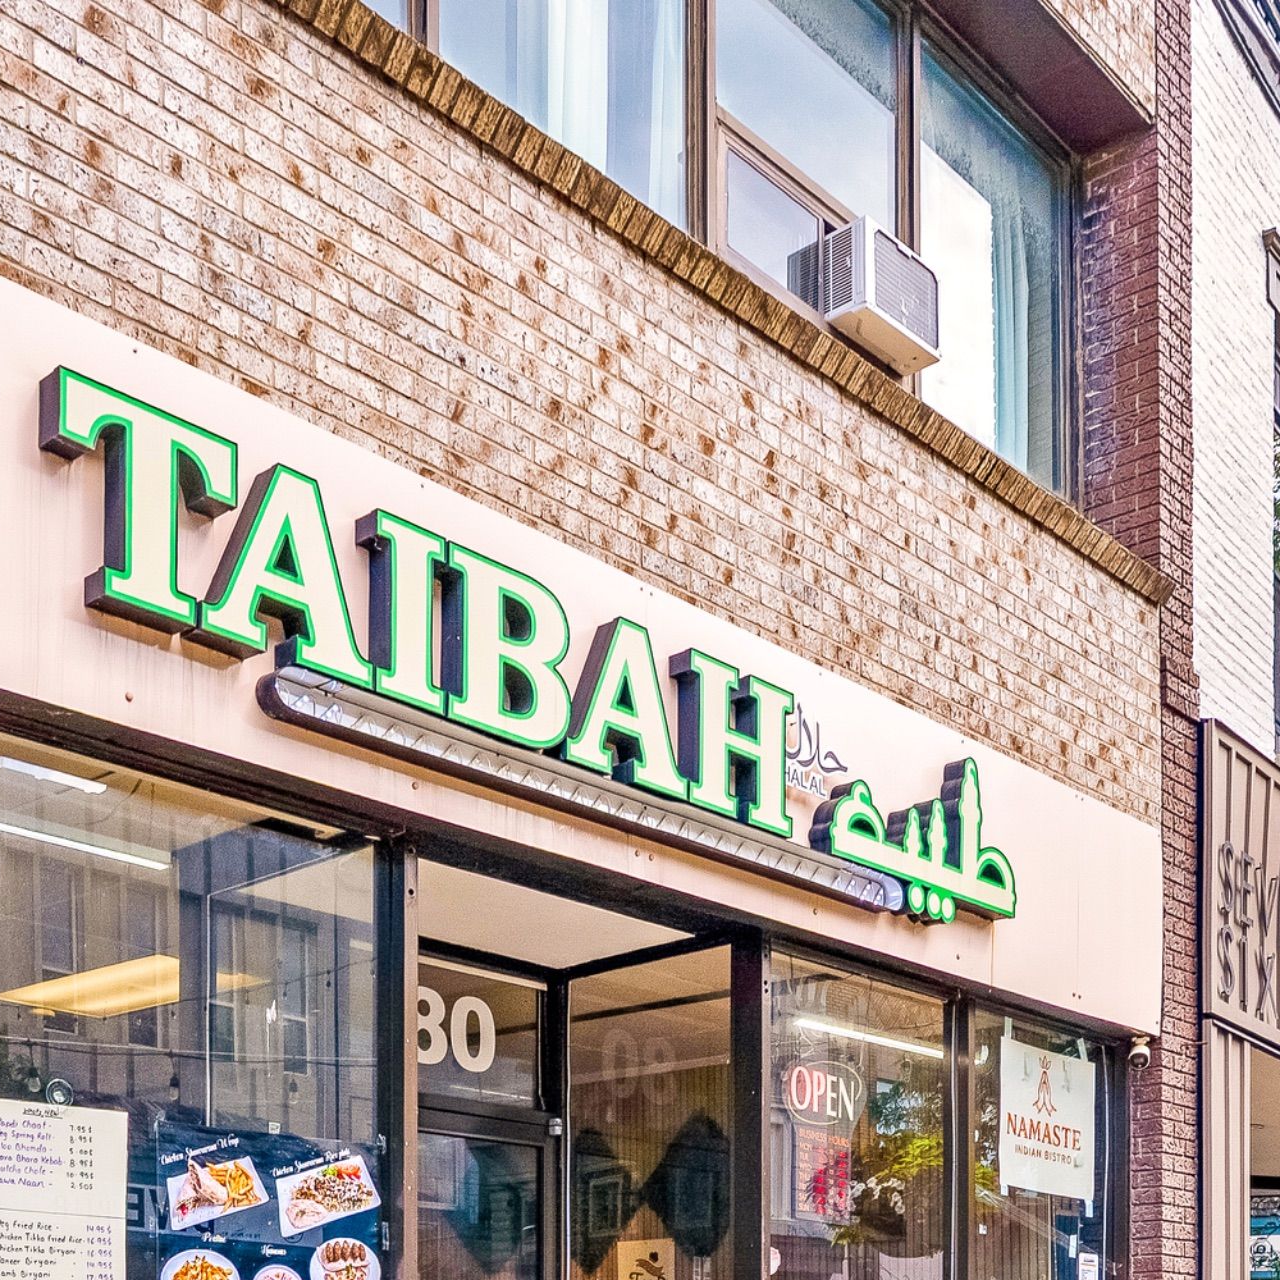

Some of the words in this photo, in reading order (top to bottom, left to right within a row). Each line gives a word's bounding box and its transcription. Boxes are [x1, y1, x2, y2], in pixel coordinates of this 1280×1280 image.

[44, 364, 795, 838] TAIBAH
[785, 766, 827, 797] HALAL
[790, 1065, 855, 1122] OPEN
[1006, 1111, 1081, 1151] NAMASTE
[1015, 1144, 1043, 1158] INDIAN
[1045, 1148, 1072, 1164] BISTRO
